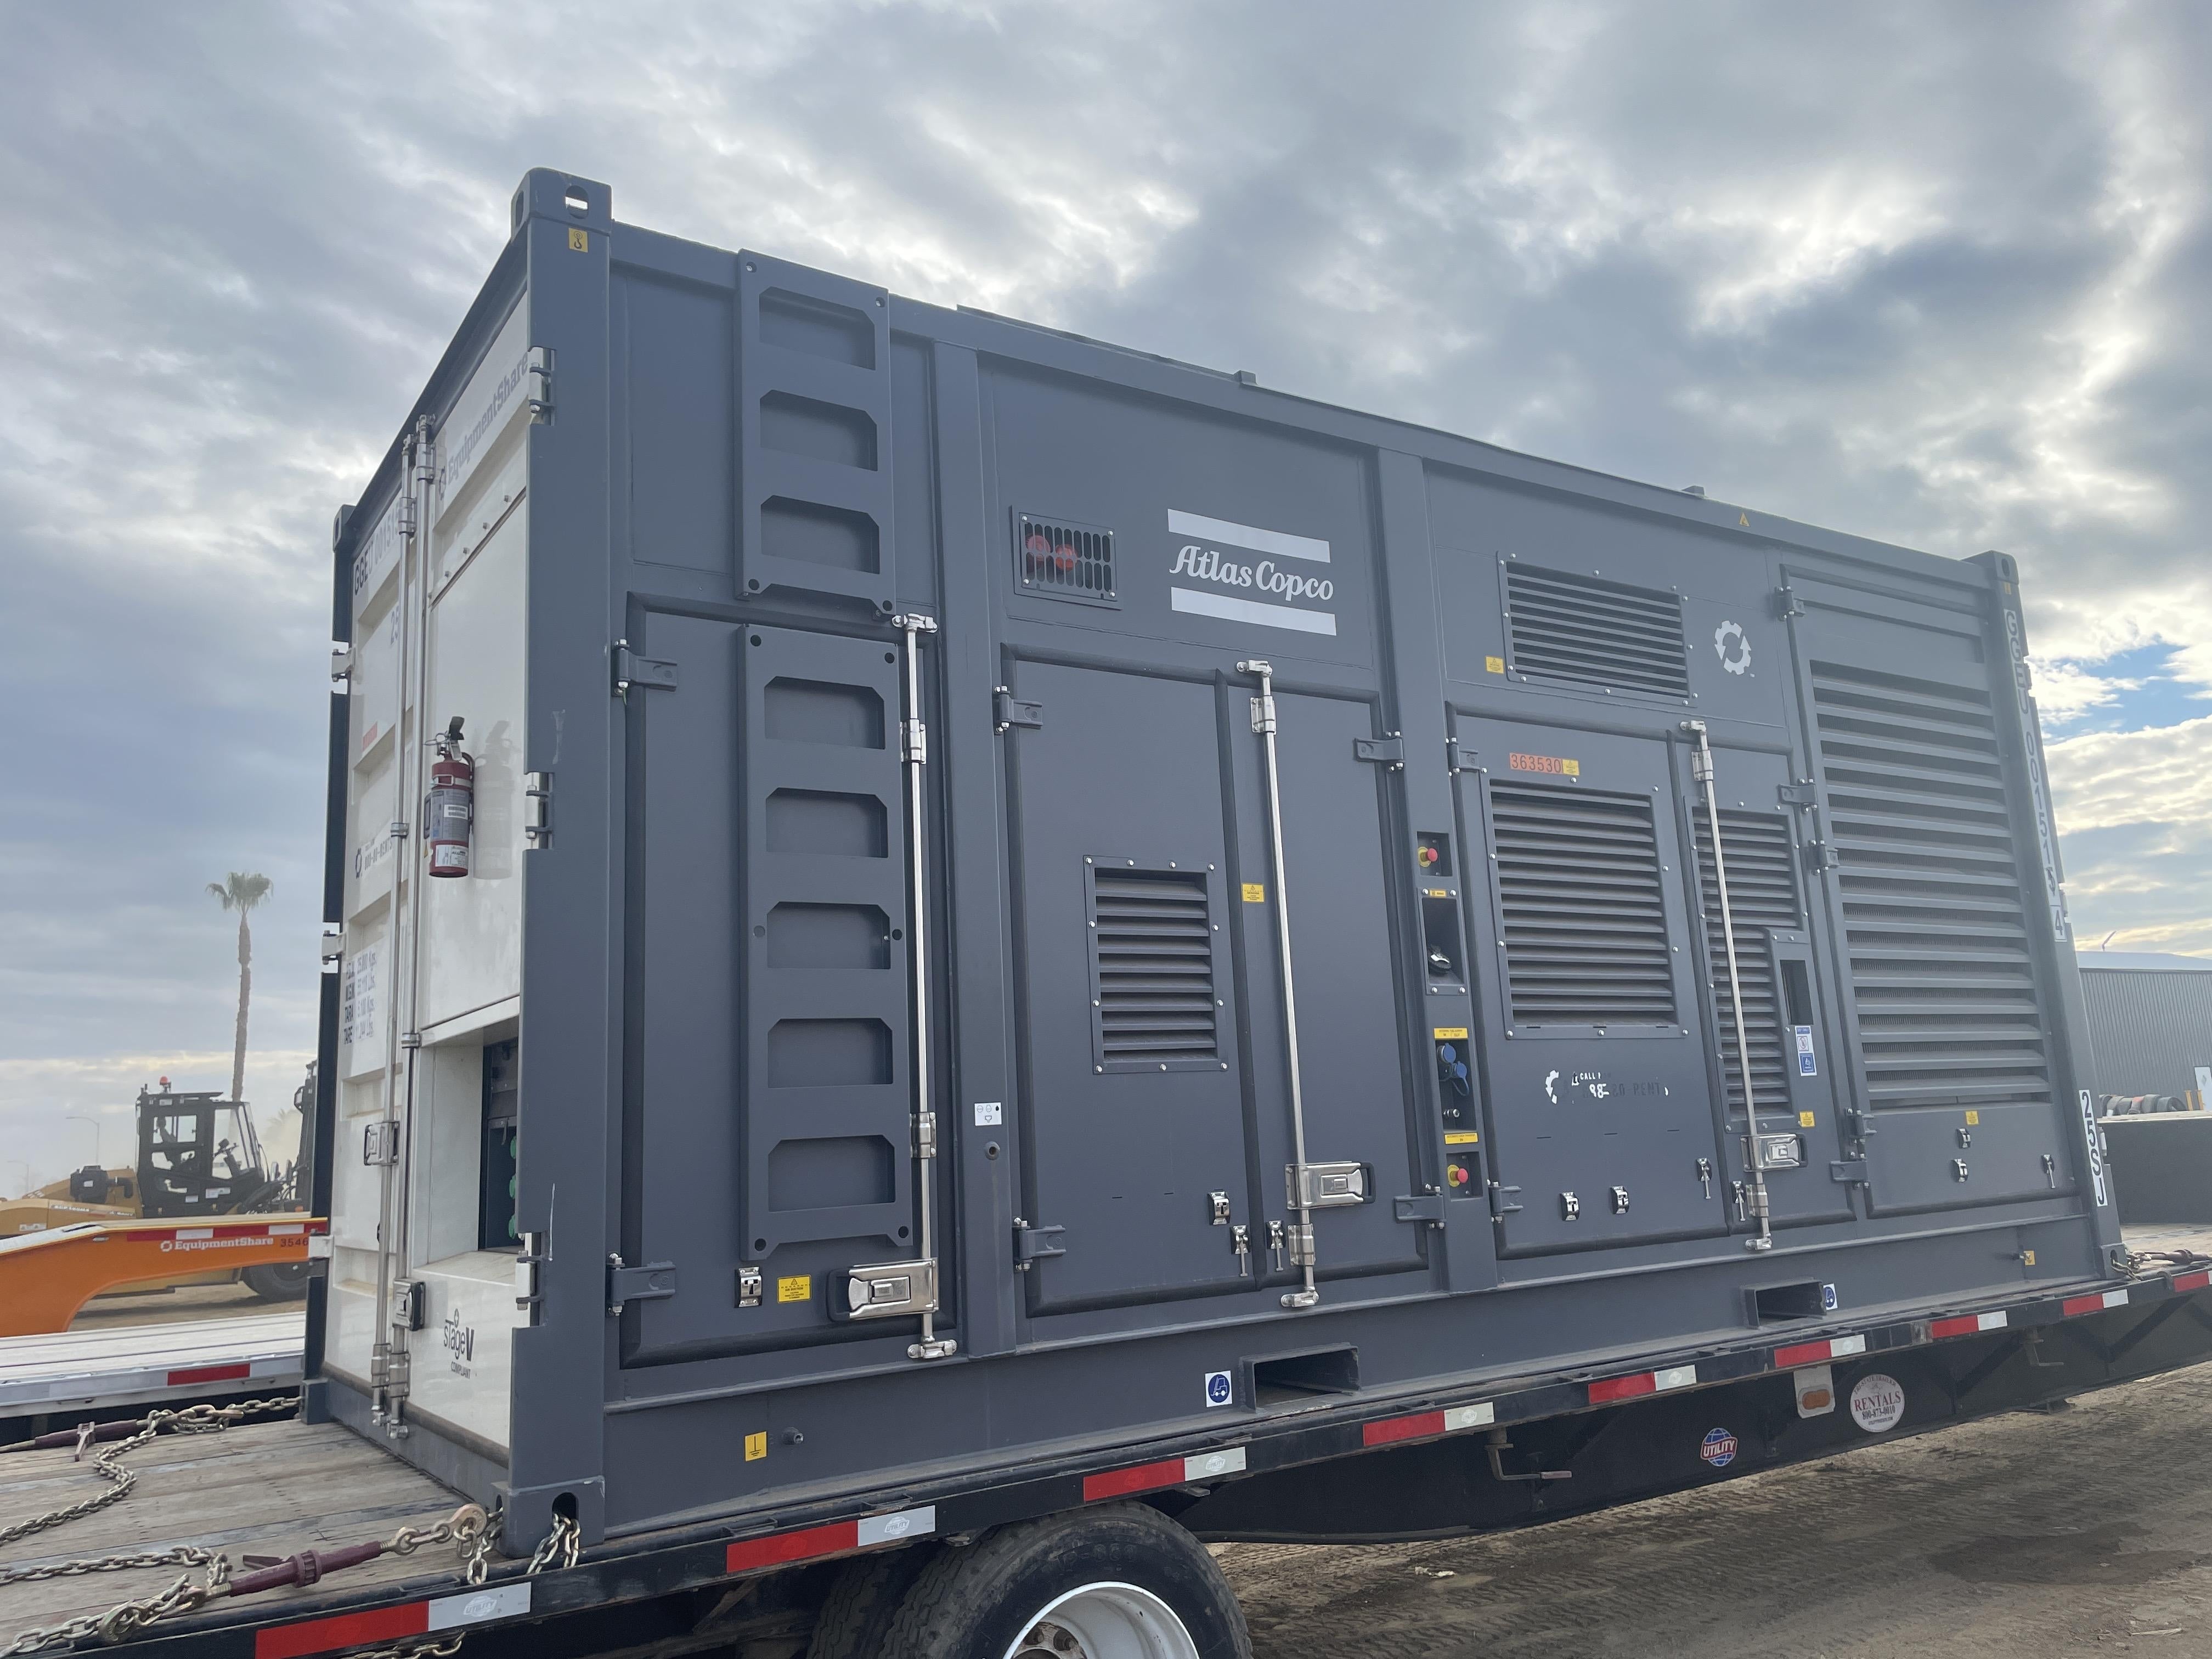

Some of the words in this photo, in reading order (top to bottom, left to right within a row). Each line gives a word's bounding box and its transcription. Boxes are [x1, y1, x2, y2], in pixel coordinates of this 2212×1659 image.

[448, 352, 528, 484] EquipmentShare
[354, 540, 374, 596] GGEU
[1169, 545, 1252, 588] Atlas
[1255, 560, 1334, 601] Copco
[2005, 611, 2029, 714] GGEU
[1511, 754, 1561, 773] 363530
[2080, 1091, 2107, 1205] 25SJ
[174, 1237, 274, 1251] EquipmentShare
[451, 1361, 471, 1379] COMPLIANT
[1854, 1391, 1901, 1412] RENTALS
[1703, 1440, 1735, 1457] UTILITY
[886, 1520, 908, 1532] UTILITY
